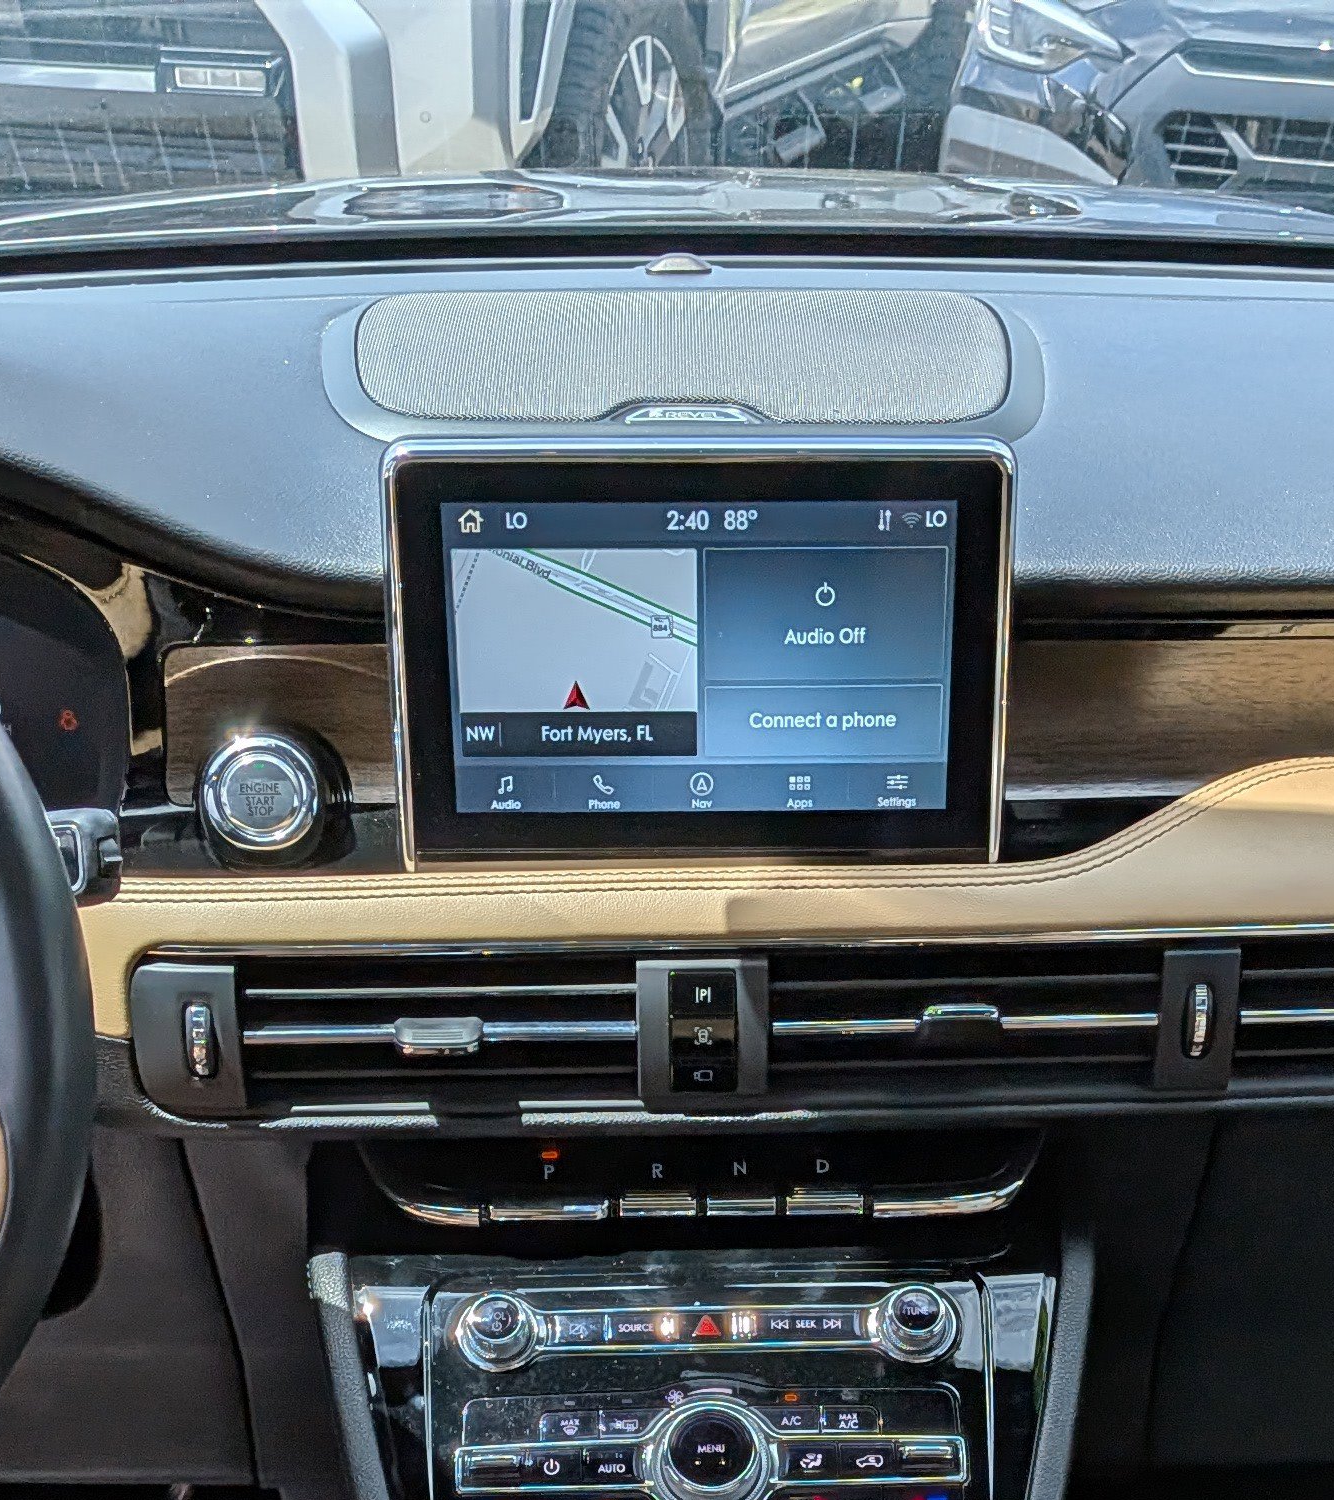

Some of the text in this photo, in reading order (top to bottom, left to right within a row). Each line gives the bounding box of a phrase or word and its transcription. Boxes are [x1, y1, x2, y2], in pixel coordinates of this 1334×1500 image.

[505, 513, 527, 530] LO
[667, 511, 710, 531] 2:40
[925, 511, 947, 528] LO
[525, 559, 551, 579] Blvd
[784, 627, 866, 645] Audio Off
[749, 711, 897, 730] Connect a phone
[466, 725, 495, 741] NW
[541, 724, 654, 744] Fort Myers, FL
[239, 782, 280, 793] ENGINE
[245, 796, 275, 806] START
[490, 800, 521, 810] Audio
[588, 799, 621, 810] Phone
[691, 799, 713, 809] Nav
[786, 799, 814, 810] Apps
[877, 796, 917, 808] Settings
[248, 806, 274, 816] STOP
[544, 1164, 555, 1179] P
[651, 1163, 664, 1179] R
[733, 1161, 747, 1176] N
[816, 1159, 830, 1174] D
[618, 1323, 654, 1333] SOURCE
[795, 1319, 817, 1329] SEEK
[781, 1415, 802, 1426] A/C
[839, 1420, 859, 1428] A/C
[697, 1443, 726, 1454] MENU
[598, 1463, 626, 1474] AUTO
